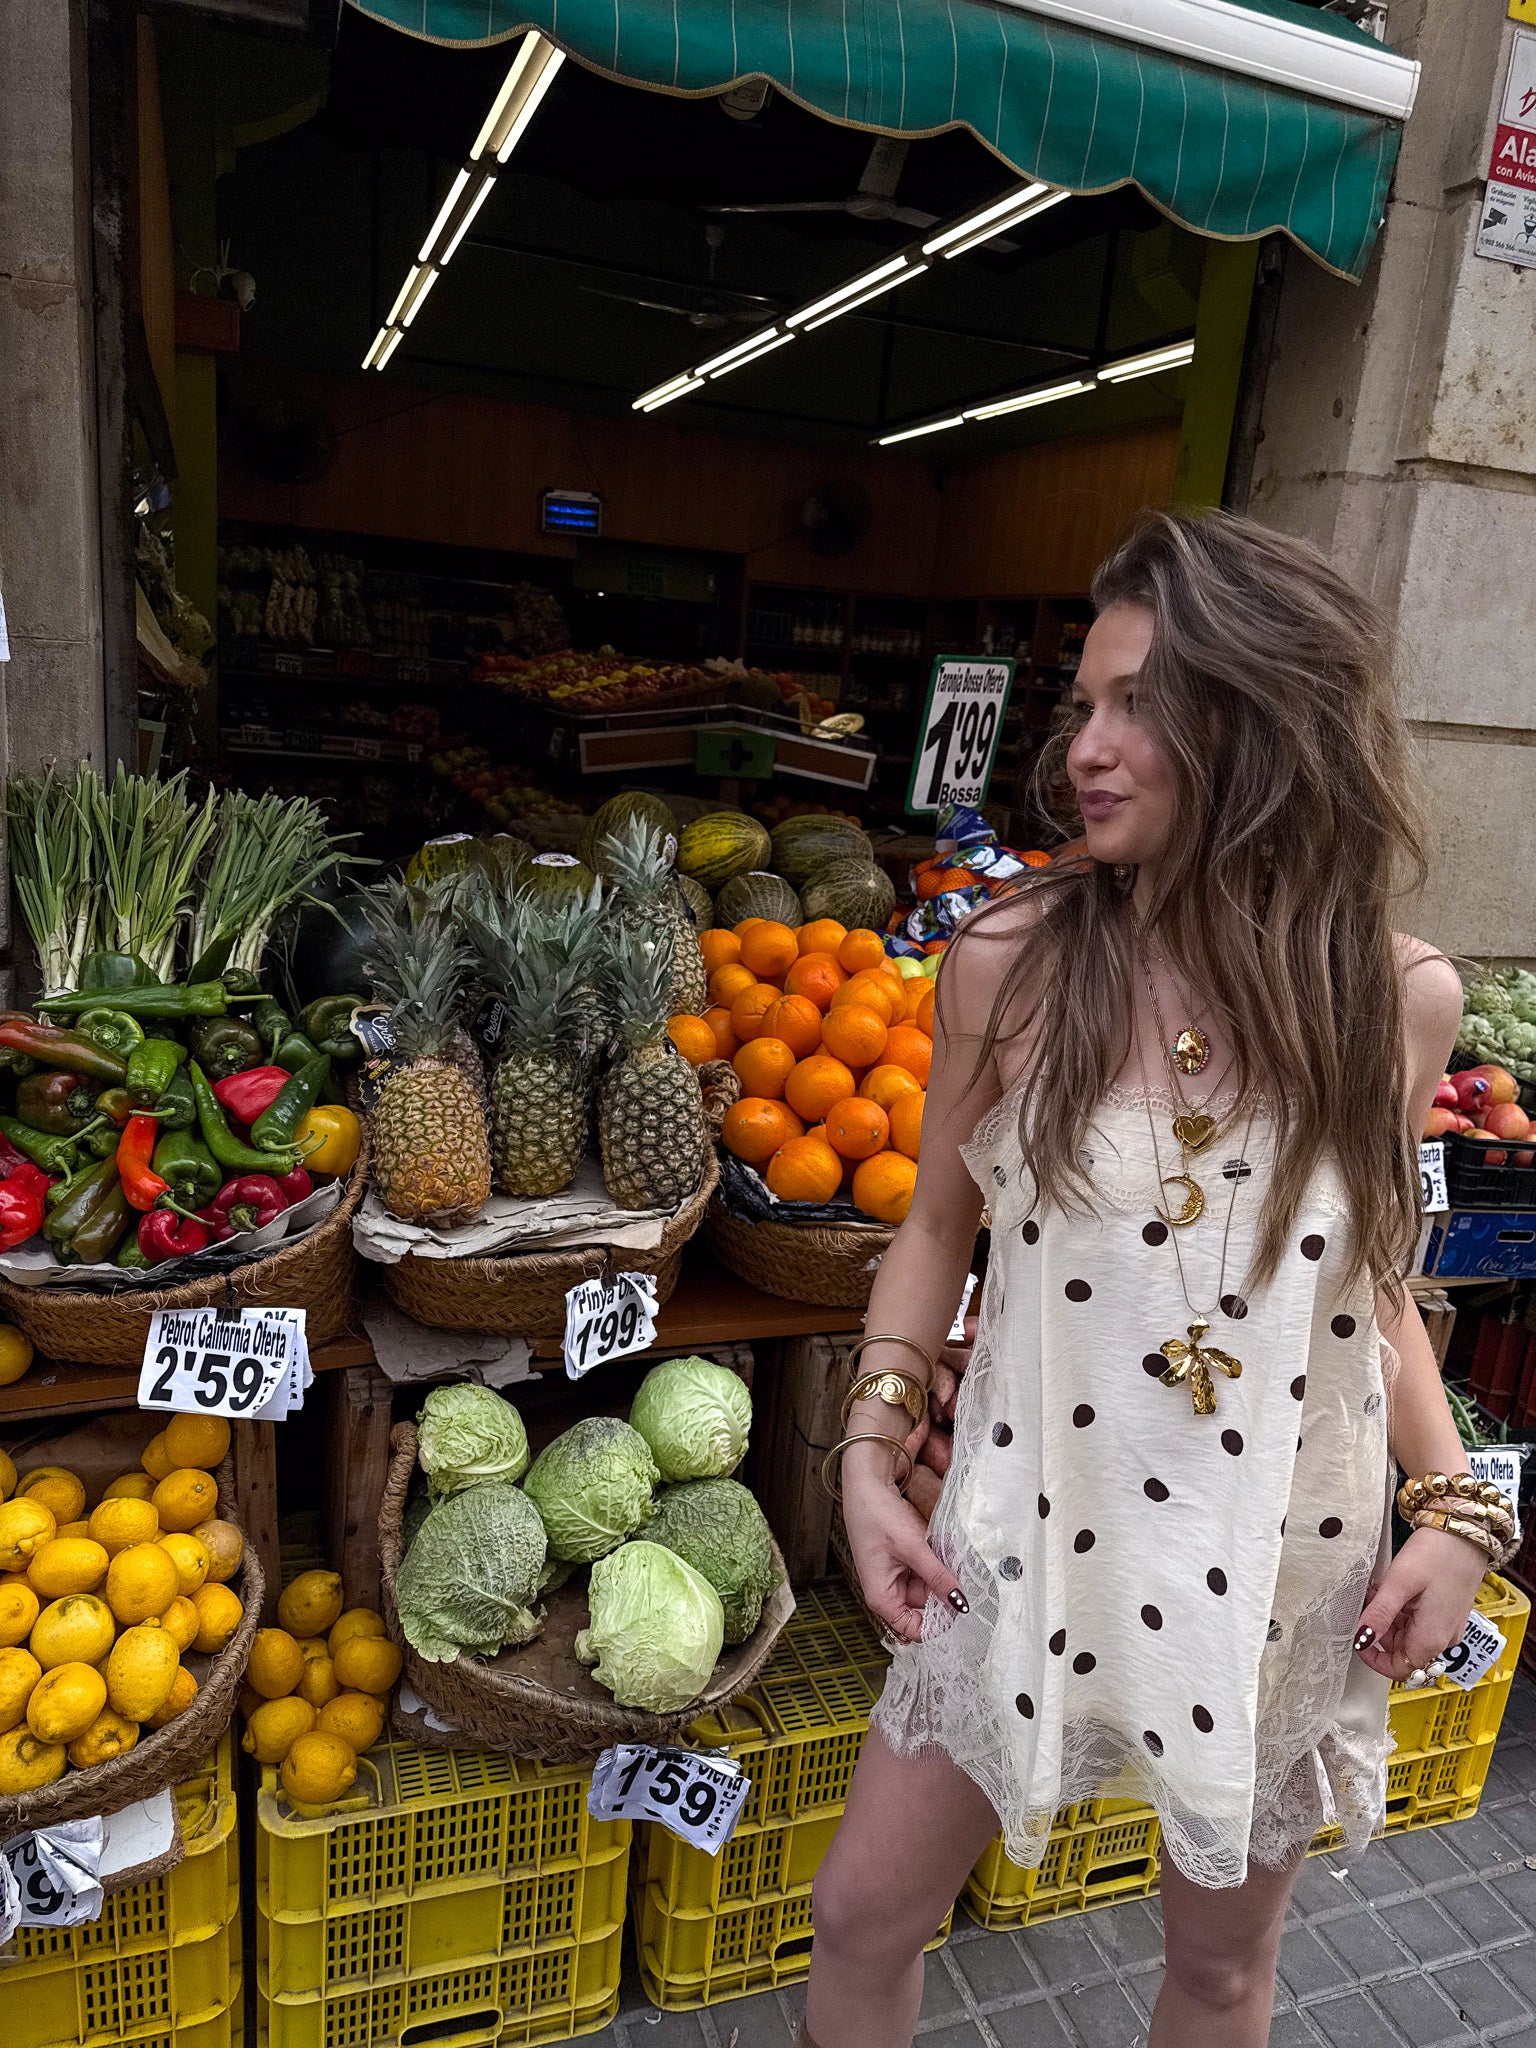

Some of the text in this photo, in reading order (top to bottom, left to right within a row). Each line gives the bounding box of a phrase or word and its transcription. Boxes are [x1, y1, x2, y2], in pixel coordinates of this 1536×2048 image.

[1495, 165, 1513, 178] con
[924, 701, 997, 804] 1'99
[940, 783, 982, 803] Bossa
[158, 1313, 287, 1359] Pebrot California Oferta
[576, 1302, 638, 1367] 1'99
[149, 1346, 264, 1411] 2'59
[1490, 1457, 1514, 1480] Oferta
[618, 1754, 717, 1827] 1'59
